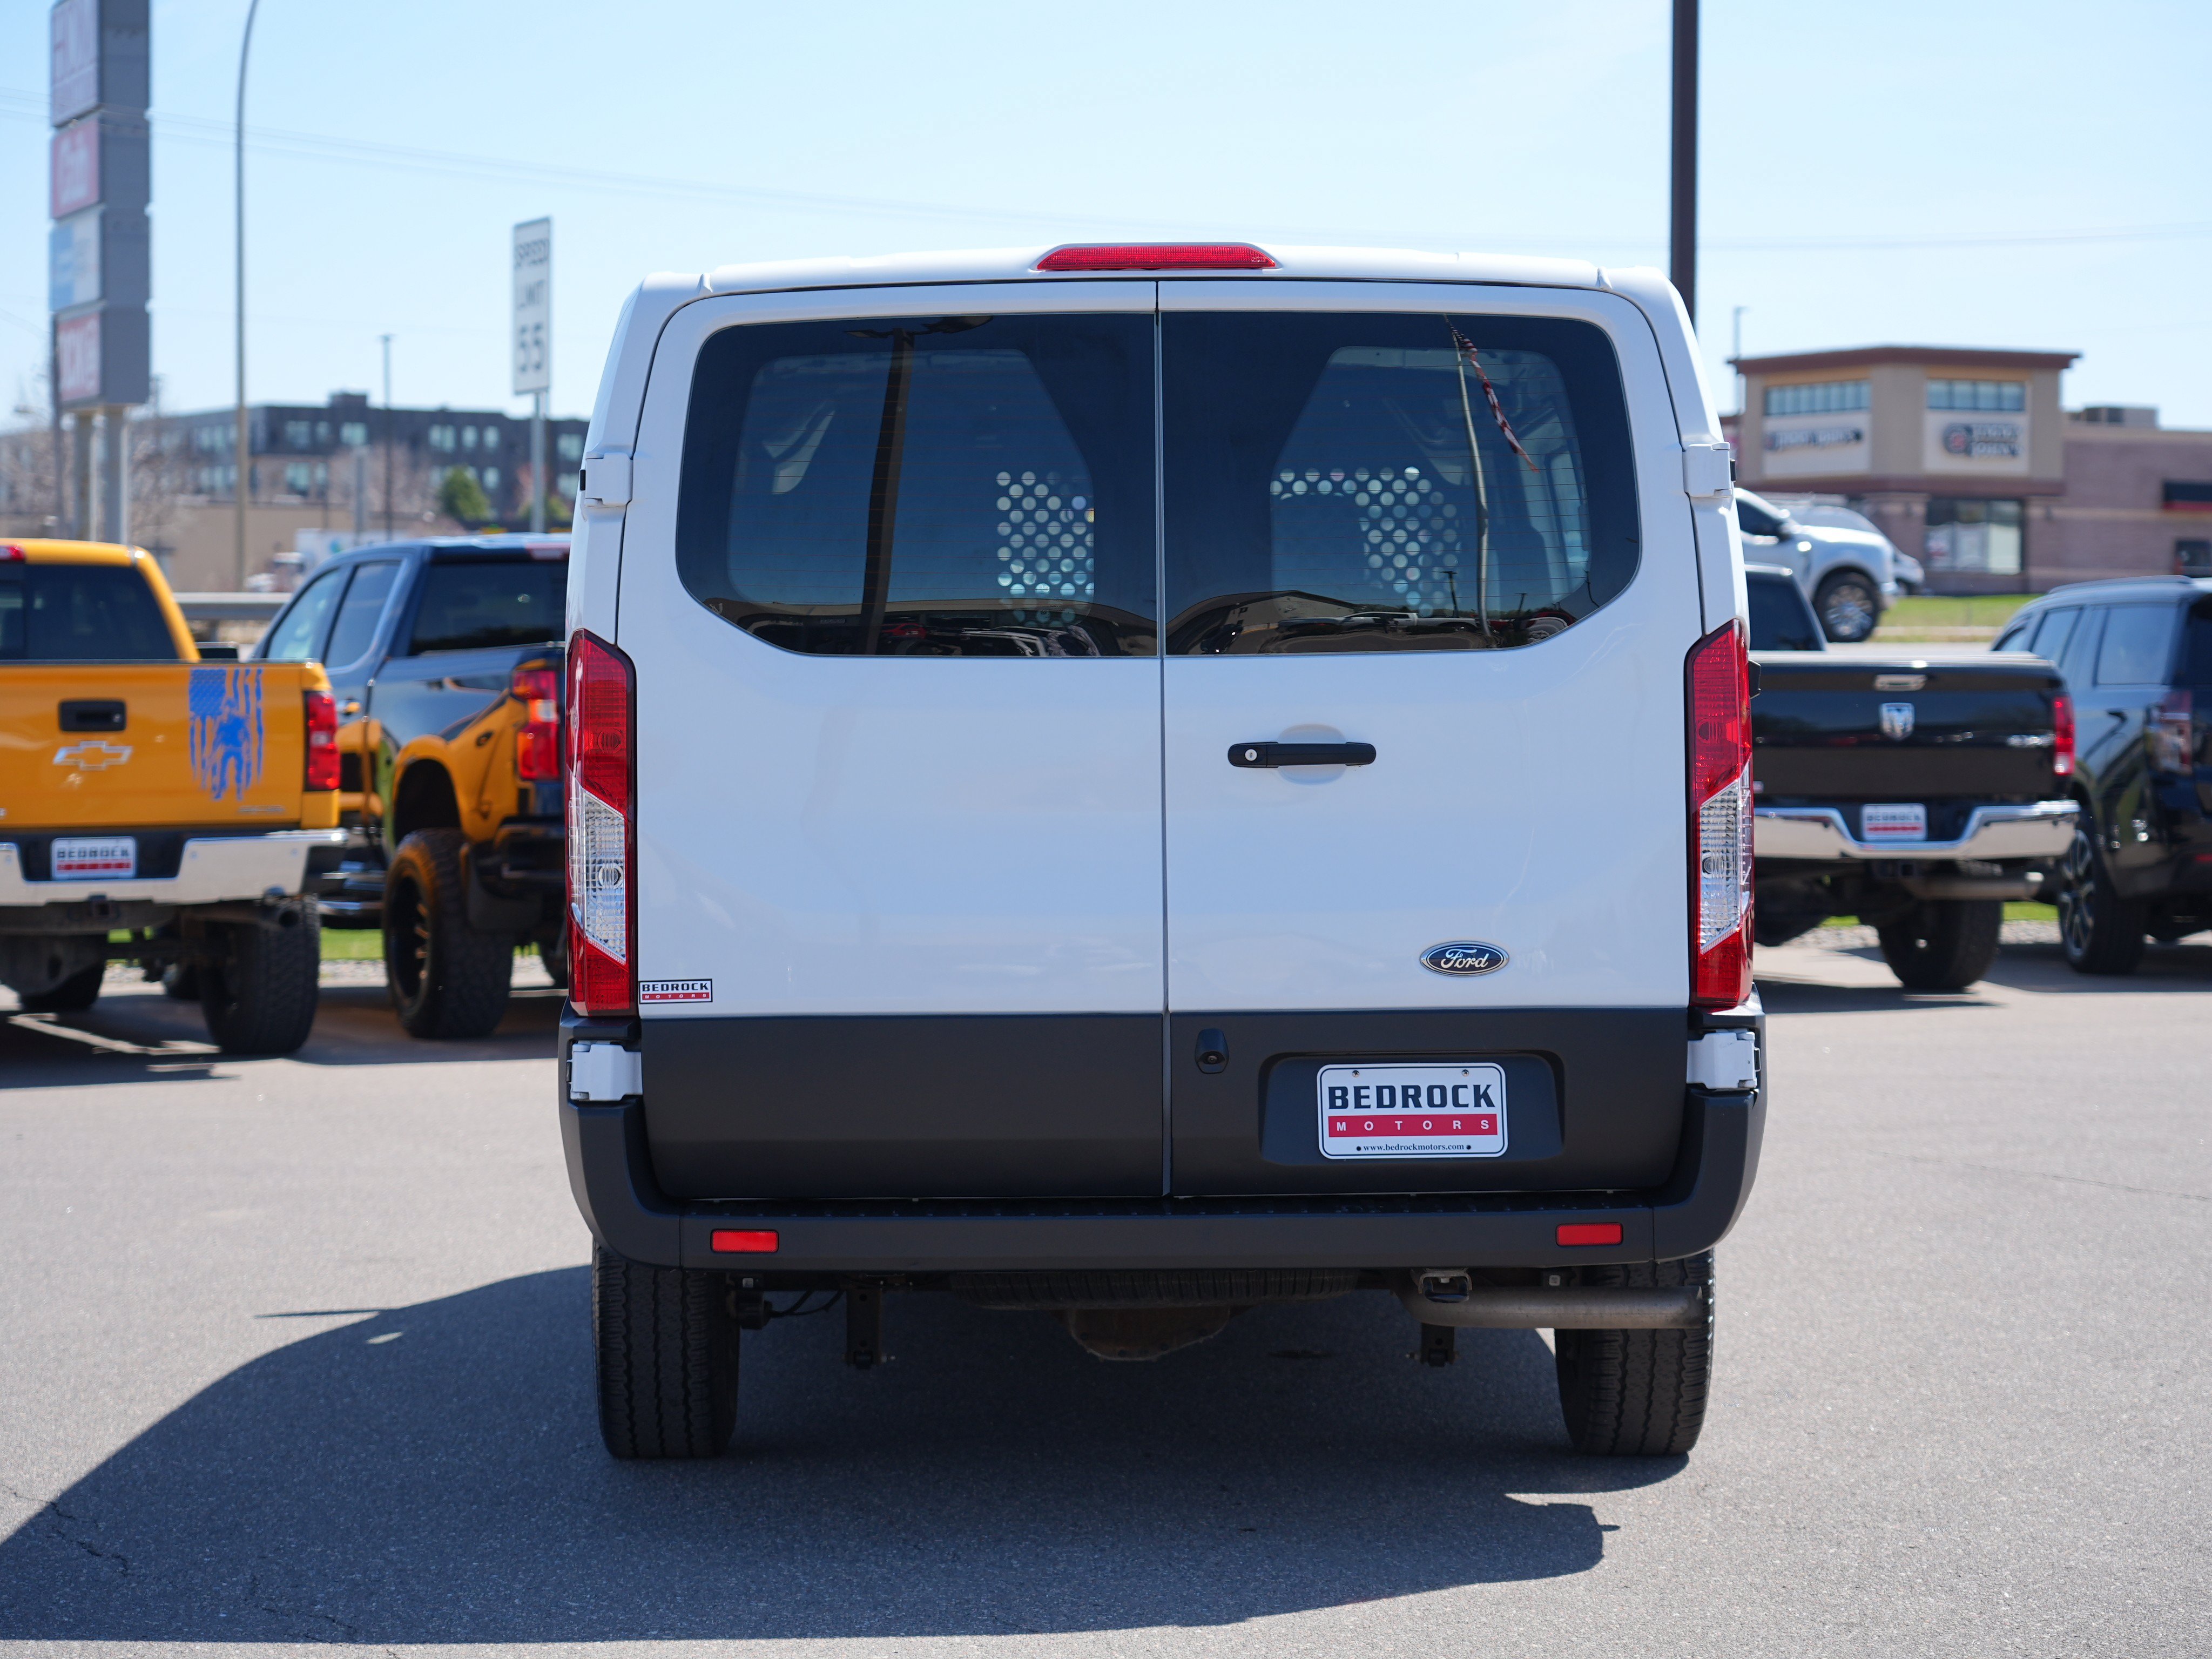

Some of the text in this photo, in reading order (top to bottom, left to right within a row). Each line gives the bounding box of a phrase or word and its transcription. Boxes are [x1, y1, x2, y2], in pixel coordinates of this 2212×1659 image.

[518, 322, 544, 373] 55
[1440, 948, 1489, 969] Ford
[642, 983, 709, 992] BEDROCK
[1328, 1084, 1495, 1110] BEDROCK
[1337, 1120, 1489, 1132] MOTORS
[1363, 1143, 1465, 1151] www.bedrockmotors.com
